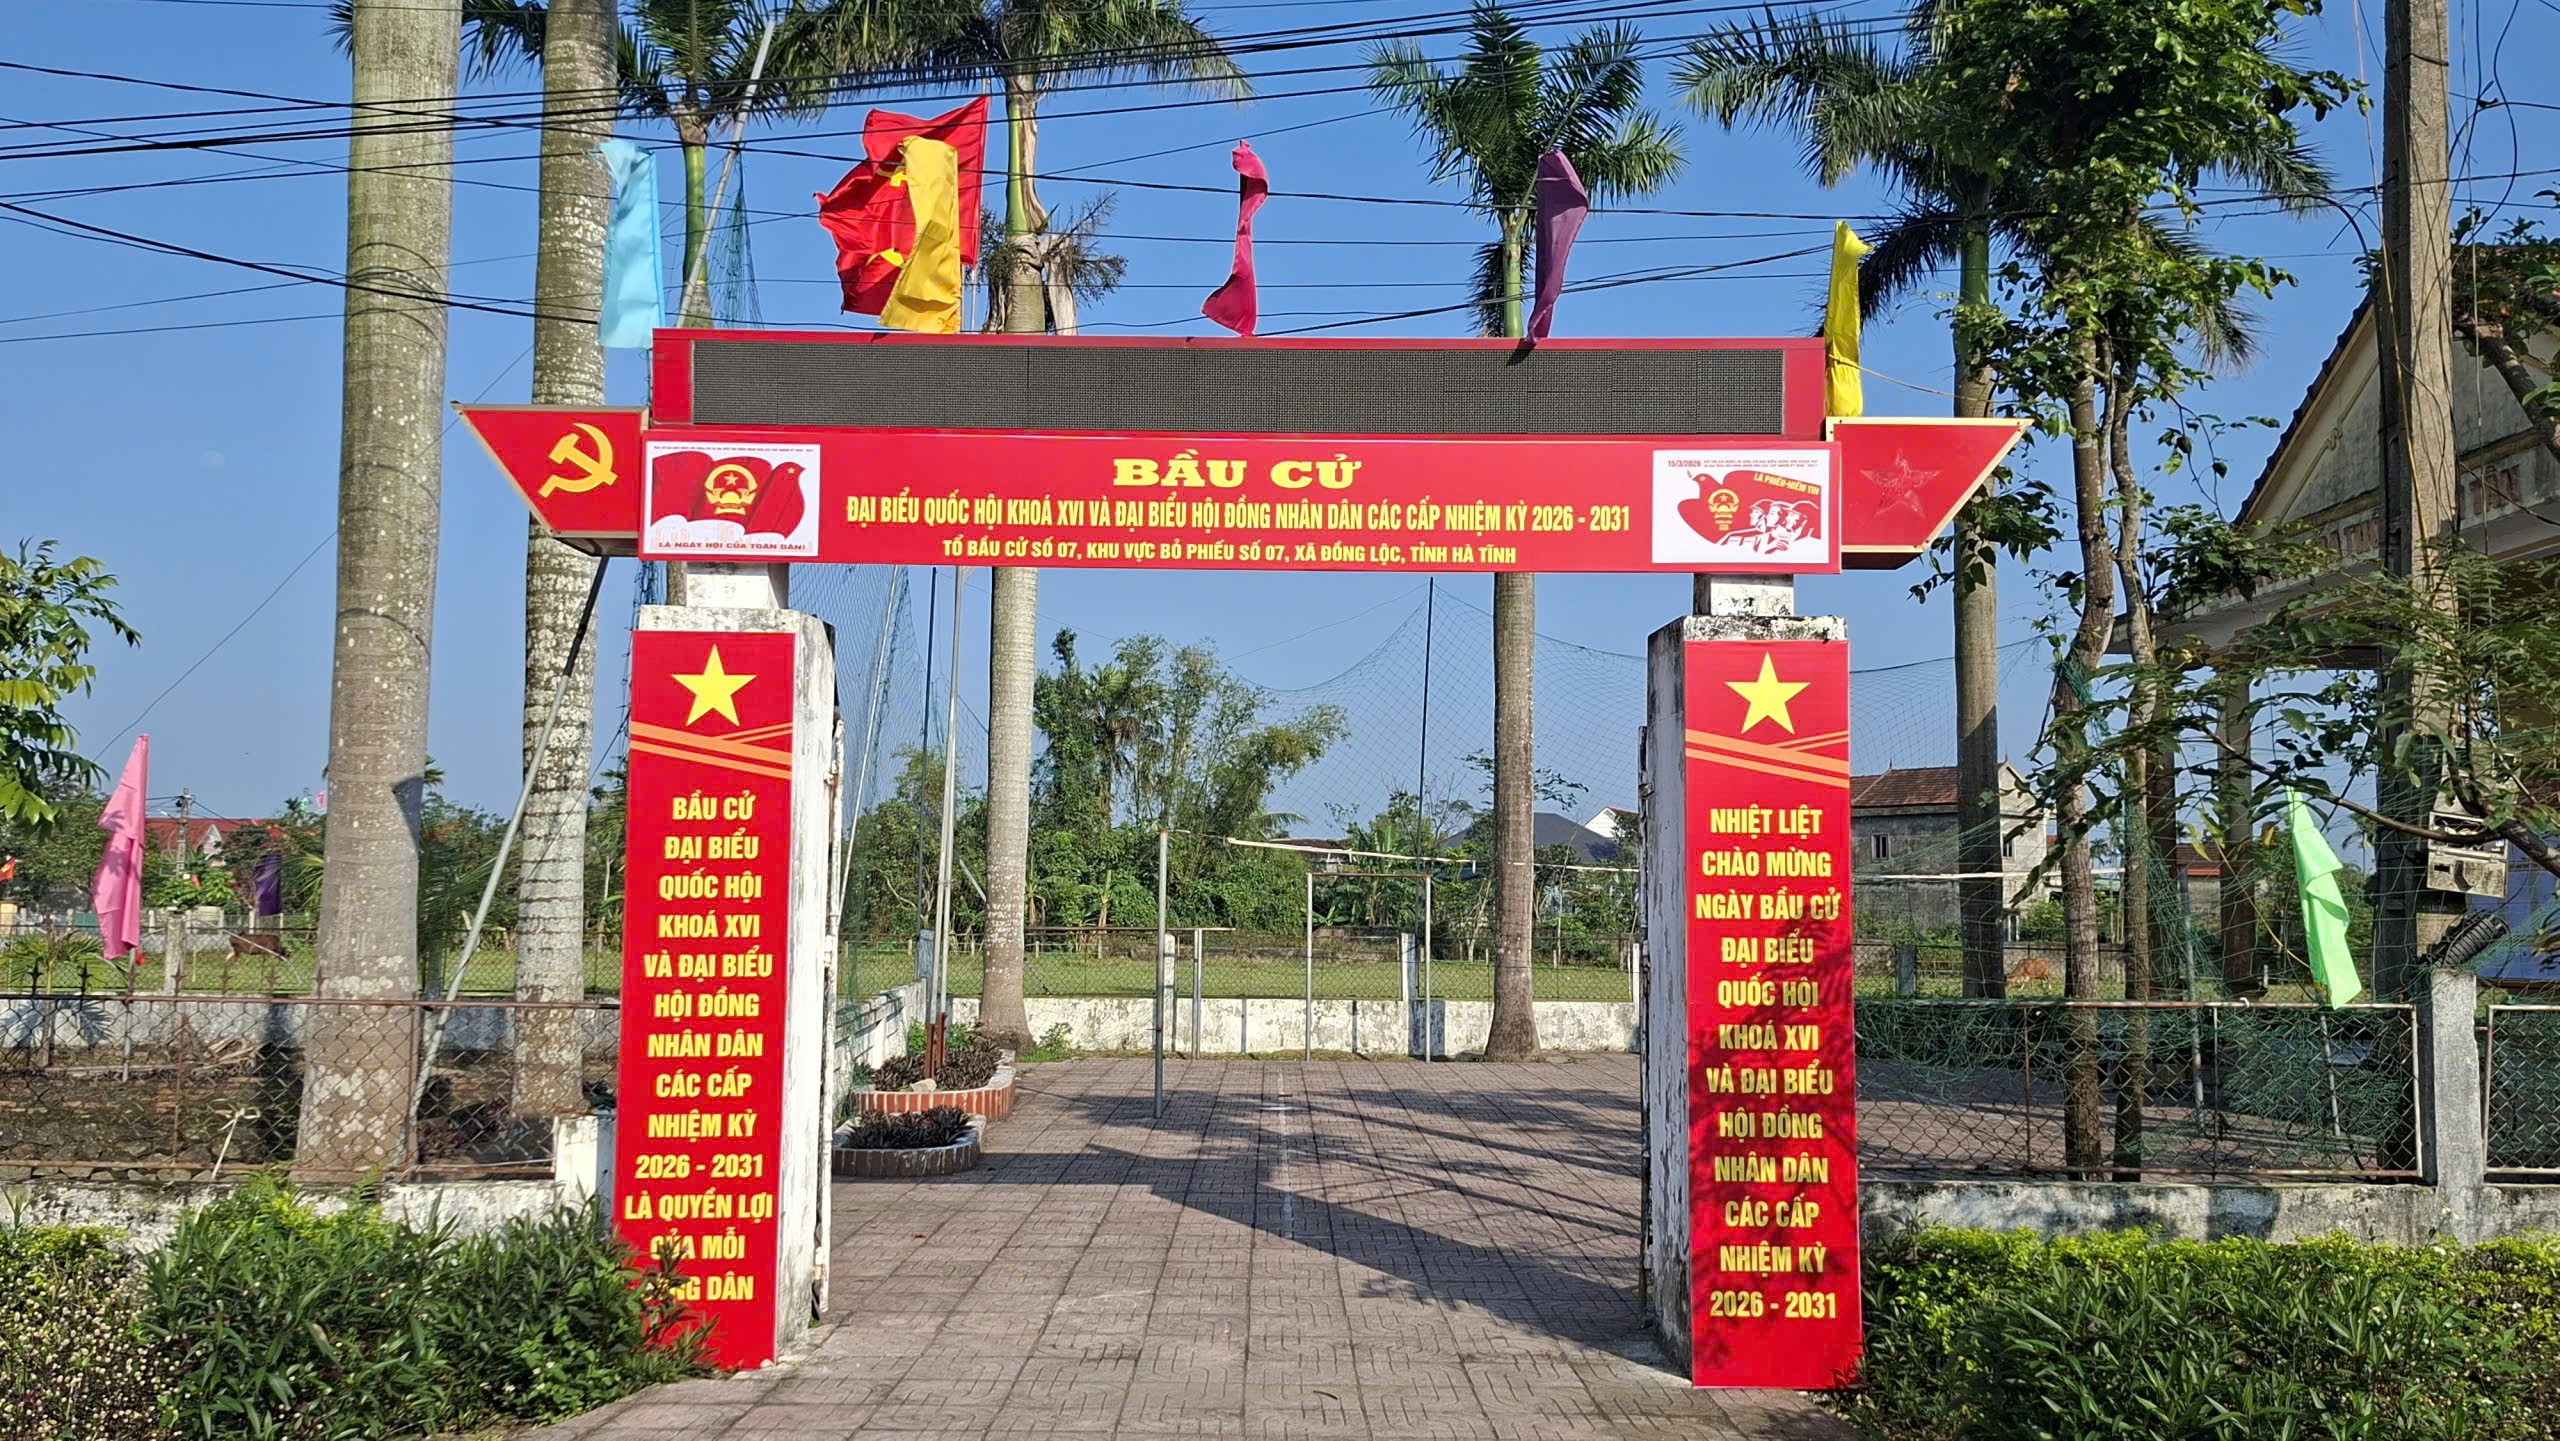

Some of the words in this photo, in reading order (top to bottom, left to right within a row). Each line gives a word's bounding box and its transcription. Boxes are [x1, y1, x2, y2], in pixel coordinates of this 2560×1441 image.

[1113, 448, 1247, 488] BẦU
[1270, 453, 1362, 489] CỬ
[847, 495, 876, 527] ĐẠI
[880, 487, 919, 523] BIỂU
[924, 489, 970, 526] QUỐC
[974, 493, 1003, 530] HỘI
[1007, 495, 1052, 526] KHOÁ
[1057, 500, 1084, 526] XVI
[1089, 495, 1111, 527] VÀ
[1115, 500, 1143, 533] ĐẠI
[1149, 491, 1187, 528] BIỂU
[1192, 497, 1220, 534] HỘI
[1224, 494, 1271, 529] ĐỒNG
[1275, 498, 1323, 529] NHÂN
[1327, 498, 1363, 530] DÂN
[1367, 499, 1401, 531] CÁC
[1406, 495, 1441, 531] CẤP
[1445, 500, 1500, 536] NHIỆM
[1505, 500, 1528, 532] KỲ
[1531, 505, 1574, 532] 2026
[1589, 505, 1630, 532] 2031
[943, 534, 964, 556] TỔ
[967, 536, 1000, 557] BẦU
[1004, 536, 1028, 557] CỬ
[1031, 536, 1054, 558] SỐ
[1058, 542, 1082, 560] 07,
[1087, 542, 1119, 559] KHU
[1124, 541, 1156, 562] VỰC
[1160, 538, 1181, 560] BỎ
[1186, 539, 1234, 561] PHIẾU
[1239, 539, 1262, 561] SỐ
[1265, 545, 1290, 563] 07,
[1294, 542, 1316, 561] XÃ
[1321, 540, 1365, 562] ĐỒNG
[1369, 543, 1405, 566] LỘC,
[1410, 541, 1448, 563] TỈNH
[1452, 543, 1474, 563] HÀ
[1478, 543, 1517, 564] TĨNH
[672, 789, 718, 821] BẦU
[722, 789, 757, 821] CỬ
[1710, 803, 1774, 840] NHIỆT
[1778, 803, 1823, 840] LIỆT
[664, 835, 703, 865] ĐẠI
[707, 827, 759, 860] BIỂU
[1701, 845, 1761, 877] CHÀO
[1765, 846, 1832, 878] MỪNG
[659, 867, 719, 901] QUỐC
[724, 870, 763, 904] HỘI
[1695, 888, 1754, 920] NGÀY
[1759, 886, 1804, 920] BẦU
[1809, 886, 1842, 921] CỬ
[658, 909, 719, 939] KHOÁ
[723, 914, 761, 938] XVI
[643, 949, 673, 978] VÀ
[677, 953, 717, 983] ĐẠI
[721, 944, 773, 978] BIỂU
[1720, 937, 1759, 969] ĐẠI
[1763, 928, 1815, 964] BIỂU
[654, 989, 693, 1023] HỘI
[697, 985, 760, 1018] ĐỒNG
[1717, 971, 1777, 1009] QUỐC
[1782, 976, 1820, 1013] HỘI
[647, 1028, 712, 1058] NHÂN
[716, 1028, 764, 1057] DÂN
[1718, 1019, 1778, 1051] KHOÁ
[1783, 1024, 1820, 1051] XVI
[655, 1069, 702, 1098] CÁC
[706, 1065, 753, 1098] CẤP
[1705, 1062, 1735, 1094] VÀ
[1740, 1067, 1778, 1100] ĐẠI
[1783, 1058, 1834, 1095] BIỂU
[647, 1108, 722, 1143] NHIỆM
[727, 1108, 758, 1137] KỲ
[1718, 1106, 1757, 1144] HỘI
[1761, 1103, 1824, 1140] ĐỒNG
[634, 1154, 691, 1179] 2026
[710, 1153, 763, 1178] 2031
[1714, 1150, 1777, 1184] NHÂN
[1782, 1151, 1829, 1184] DÂN
[624, 1189, 654, 1220] LÀ
[658, 1186, 733, 1222] QUYỀN
[737, 1191, 773, 1224] LỢI
[1724, 1194, 1770, 1228] CÁC
[1775, 1192, 1820, 1229] CẤP
[701, 1226, 746, 1260] MỖI
[1719, 1240, 1793, 1278] NHIỆM
[1798, 1241, 1828, 1274] KỲ
[706, 1270, 754, 1301] DÂN
[1710, 1290, 1765, 1319] 2026
[1770, 1302, 1780, 1311] -
[1785, 1291, 1837, 1320] 2031
